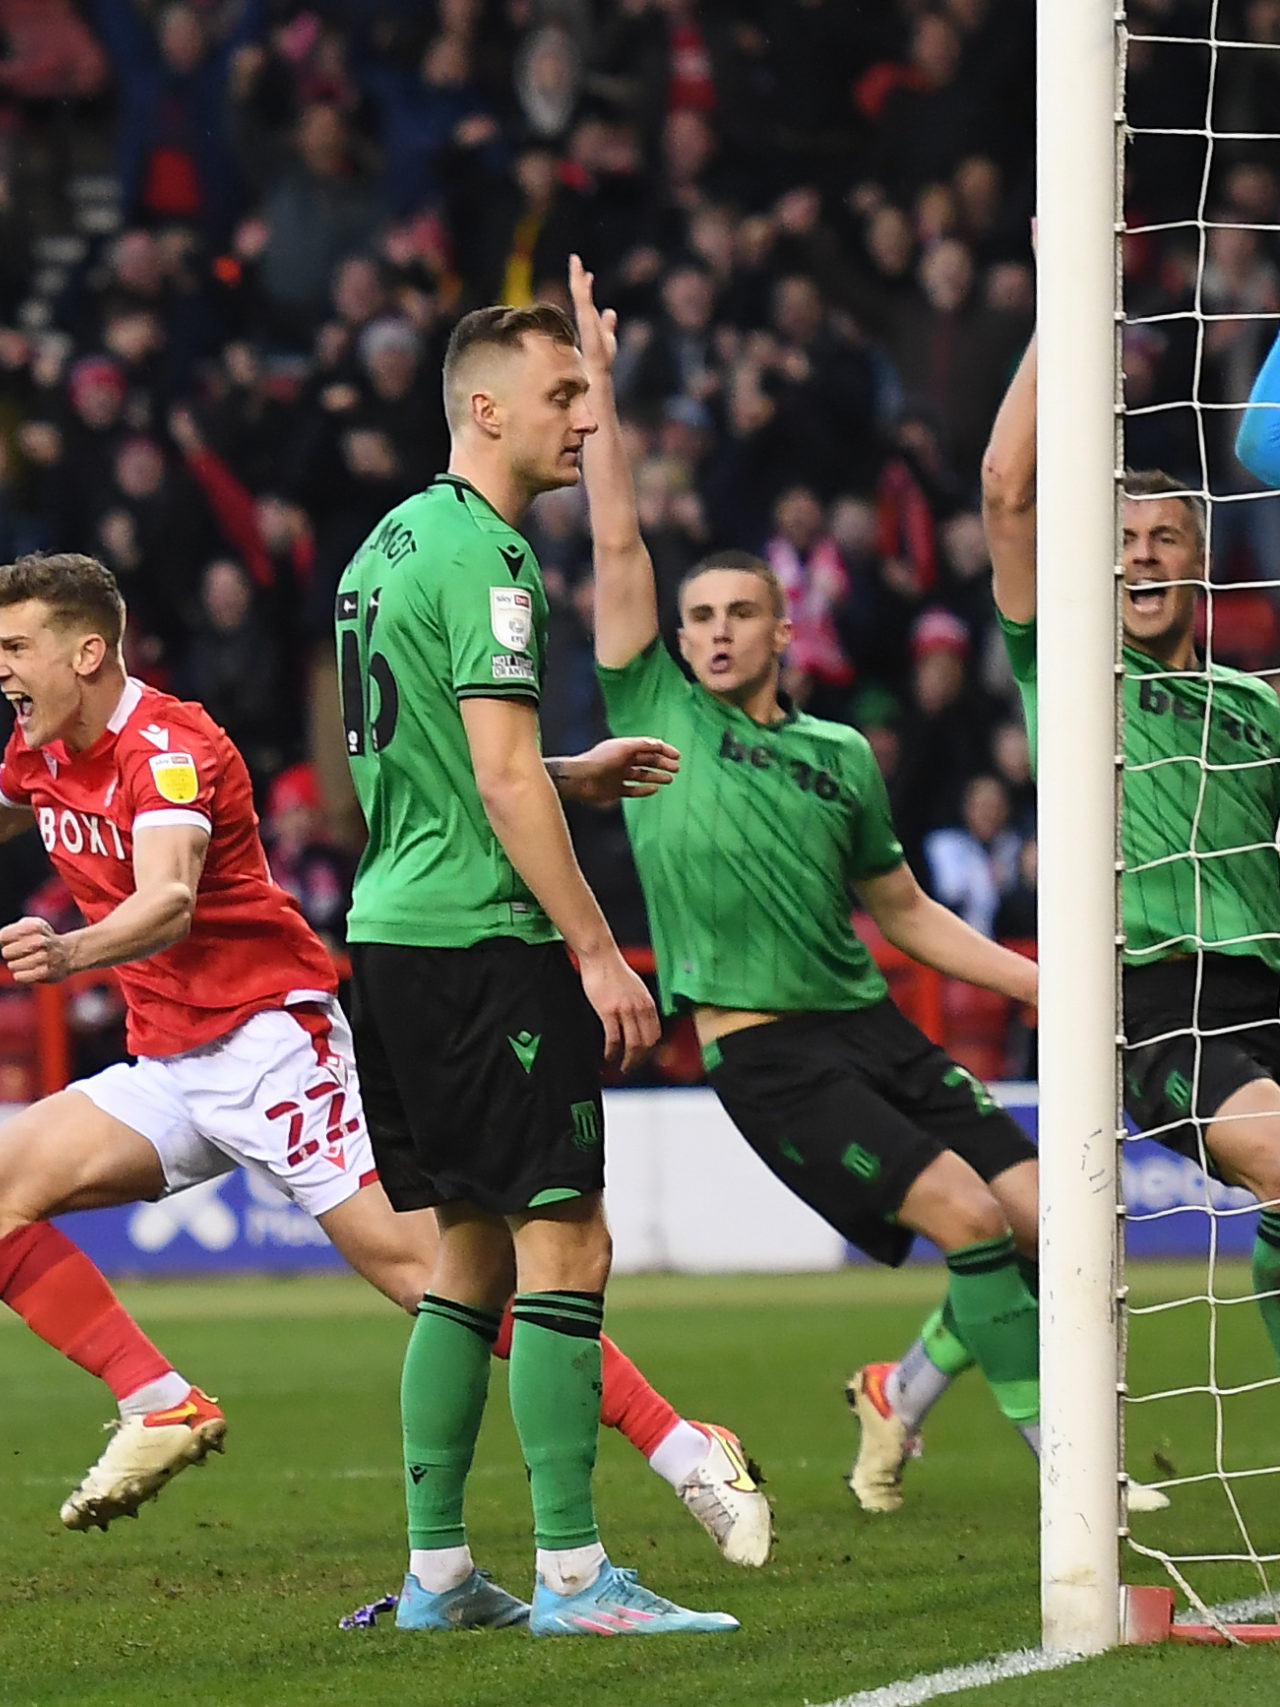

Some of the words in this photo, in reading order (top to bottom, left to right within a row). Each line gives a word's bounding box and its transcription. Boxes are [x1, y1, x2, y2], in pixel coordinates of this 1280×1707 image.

[347, 518, 418, 575] MOT
[335, 586, 399, 758] 16
[720, 728, 858, 808] be36
[38, 806, 126, 860] BOXT
[264, 1081, 361, 1168] 22
